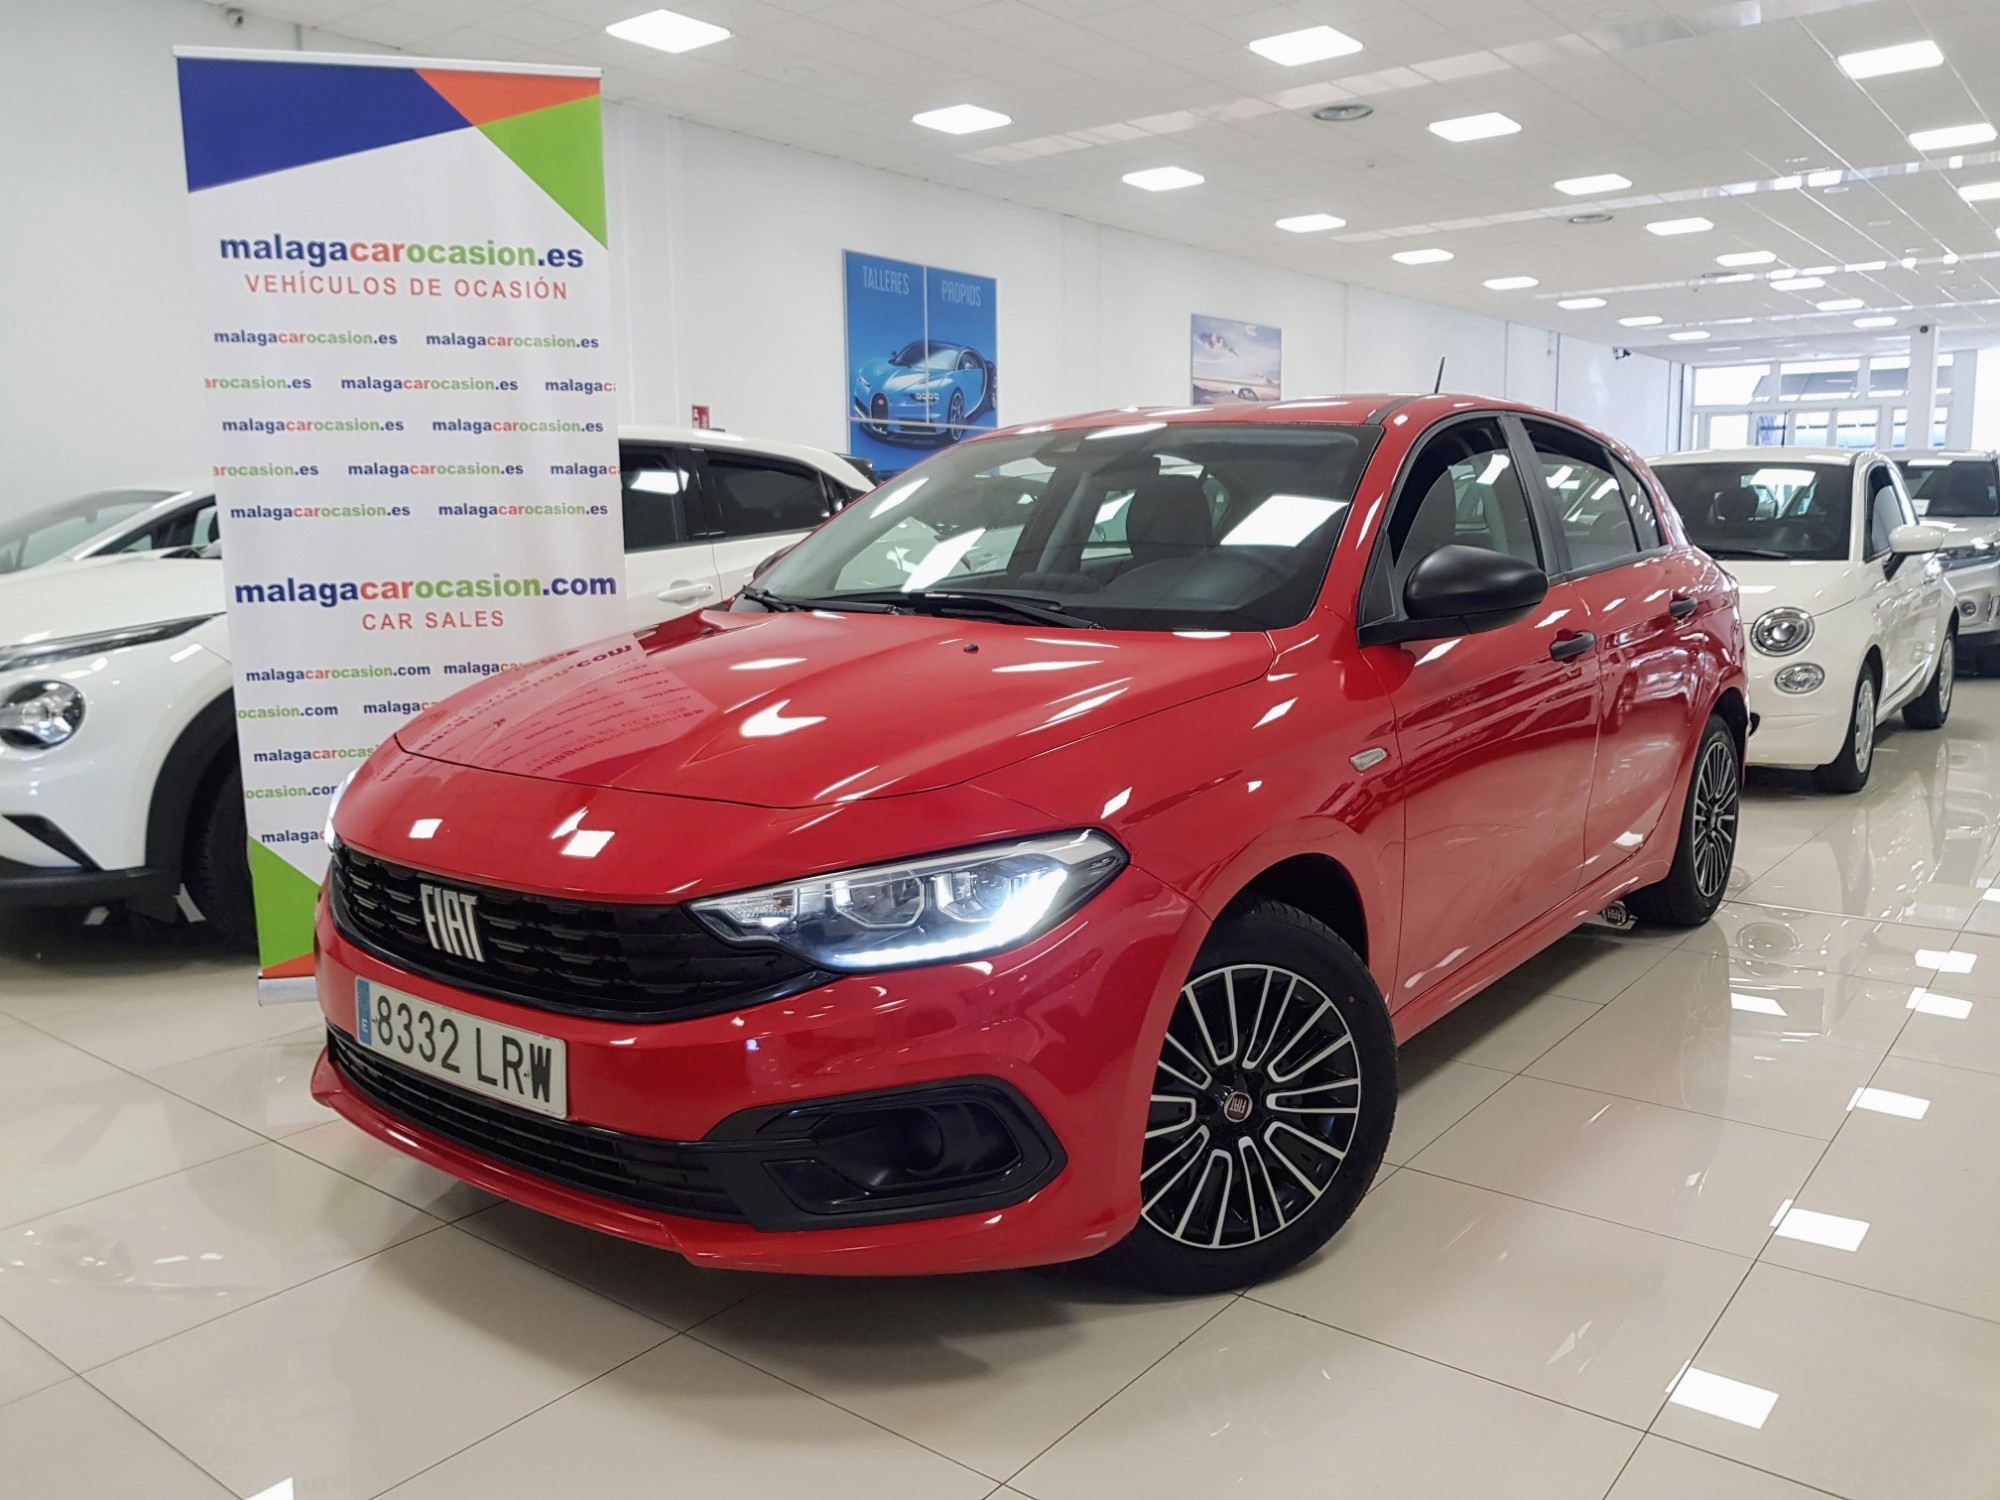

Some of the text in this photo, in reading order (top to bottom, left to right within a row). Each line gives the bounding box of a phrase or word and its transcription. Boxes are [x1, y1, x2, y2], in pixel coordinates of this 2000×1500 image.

[219, 233, 584, 268] malagacarocasion.es
[245, 270, 567, 300] VEHÍCULOS DE OCASIÓN
[862, 264, 982, 307] TALLERES PROPIOS
[214, 330, 599, 349] malagacarocasion.es malagacarocasion.es
[341, 376, 518, 393] malagacarocasion.es
[545, 379, 616, 395] malagac
[222, 418, 604, 435] malagacarocasion.es malagacarocasion.es
[348, 462, 524, 478] malagacarocasion.es
[230, 502, 609, 521] malagacarocasion.es malagacarocasion.es
[234, 573, 618, 607] malagacarocasion.com
[362, 610, 505, 631] CAR SALES
[246, 665, 431, 683] malagacarocasion.com
[253, 745, 378, 763] malagacarocas
[420, 883, 485, 962] FIAT
[377, 995, 552, 1104] 8332 LRW
[1229, 1098, 1246, 1113] FIAT
